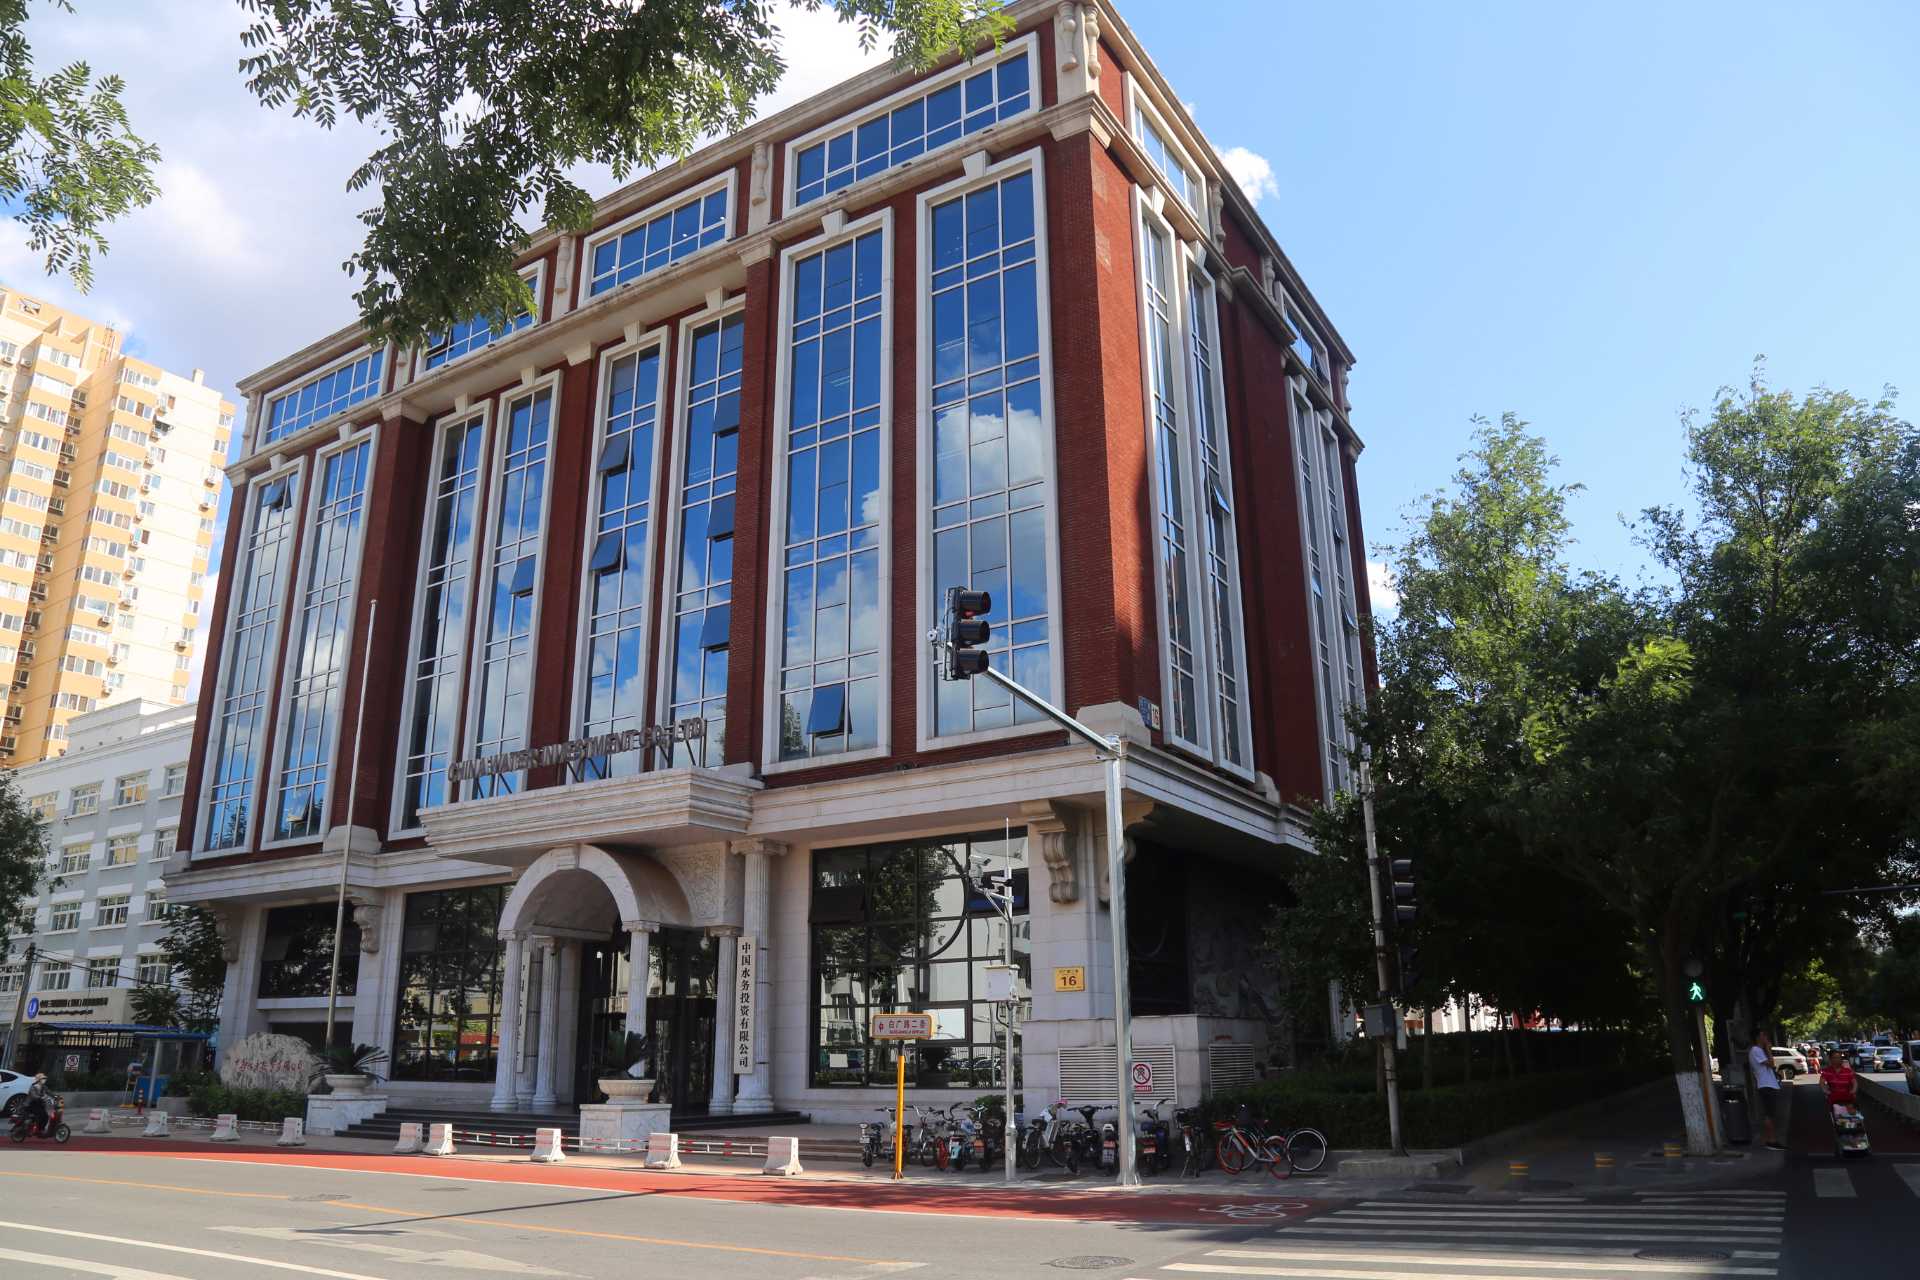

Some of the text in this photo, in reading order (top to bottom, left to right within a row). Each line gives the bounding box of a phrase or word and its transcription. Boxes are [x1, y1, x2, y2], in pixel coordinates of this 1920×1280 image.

[448, 757, 489, 782] CHINA
[489, 748, 539, 774] WATER
[541, 729, 641, 766] INVESTMENT
[739, 941, 751, 1068] 中国水务投资有限公司
[1060, 975, 1077, 987] 16
